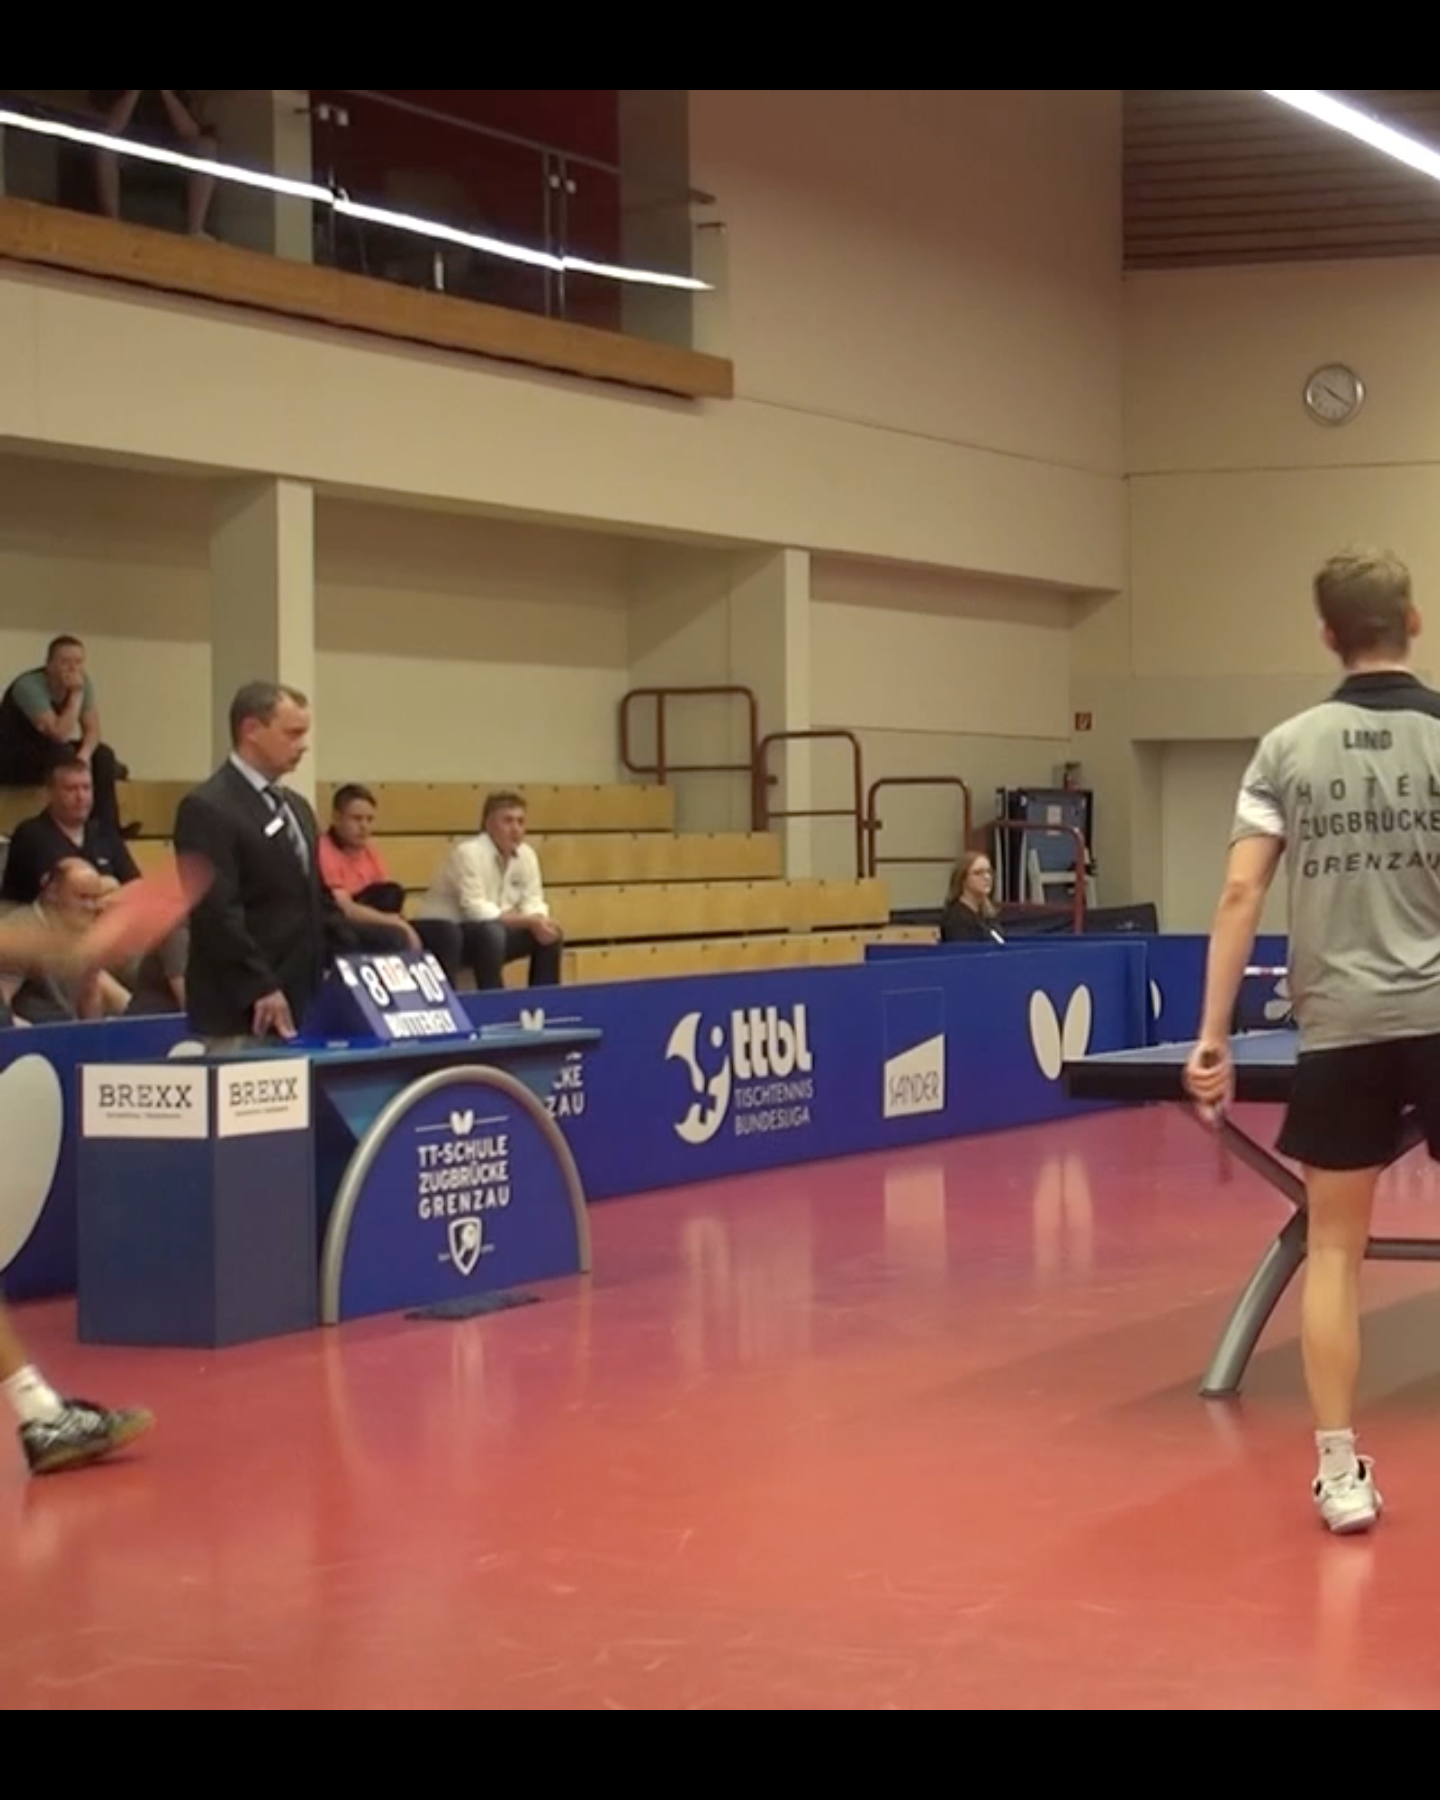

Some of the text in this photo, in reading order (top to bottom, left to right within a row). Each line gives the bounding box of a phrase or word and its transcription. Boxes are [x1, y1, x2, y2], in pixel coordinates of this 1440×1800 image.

[1342, 729, 1393, 750] LIND
[361, 964, 390, 1006] 8
[409, 961, 445, 1003] 10
[731, 1002, 812, 1080] ttbl
[98, 1083, 192, 1108] BREXX
[229, 1077, 298, 1106] BREXX
[735, 1079, 814, 1109] TISCHTENNIS
[888, 1070, 940, 1107] SANDER
[735, 1106, 811, 1137] BUNDESLIGA
[417, 1134, 509, 1169] TT-SCHULE
[418, 1160, 509, 1194] ZUGBRÜCKE
[418, 1185, 510, 1219] GRENZAU
